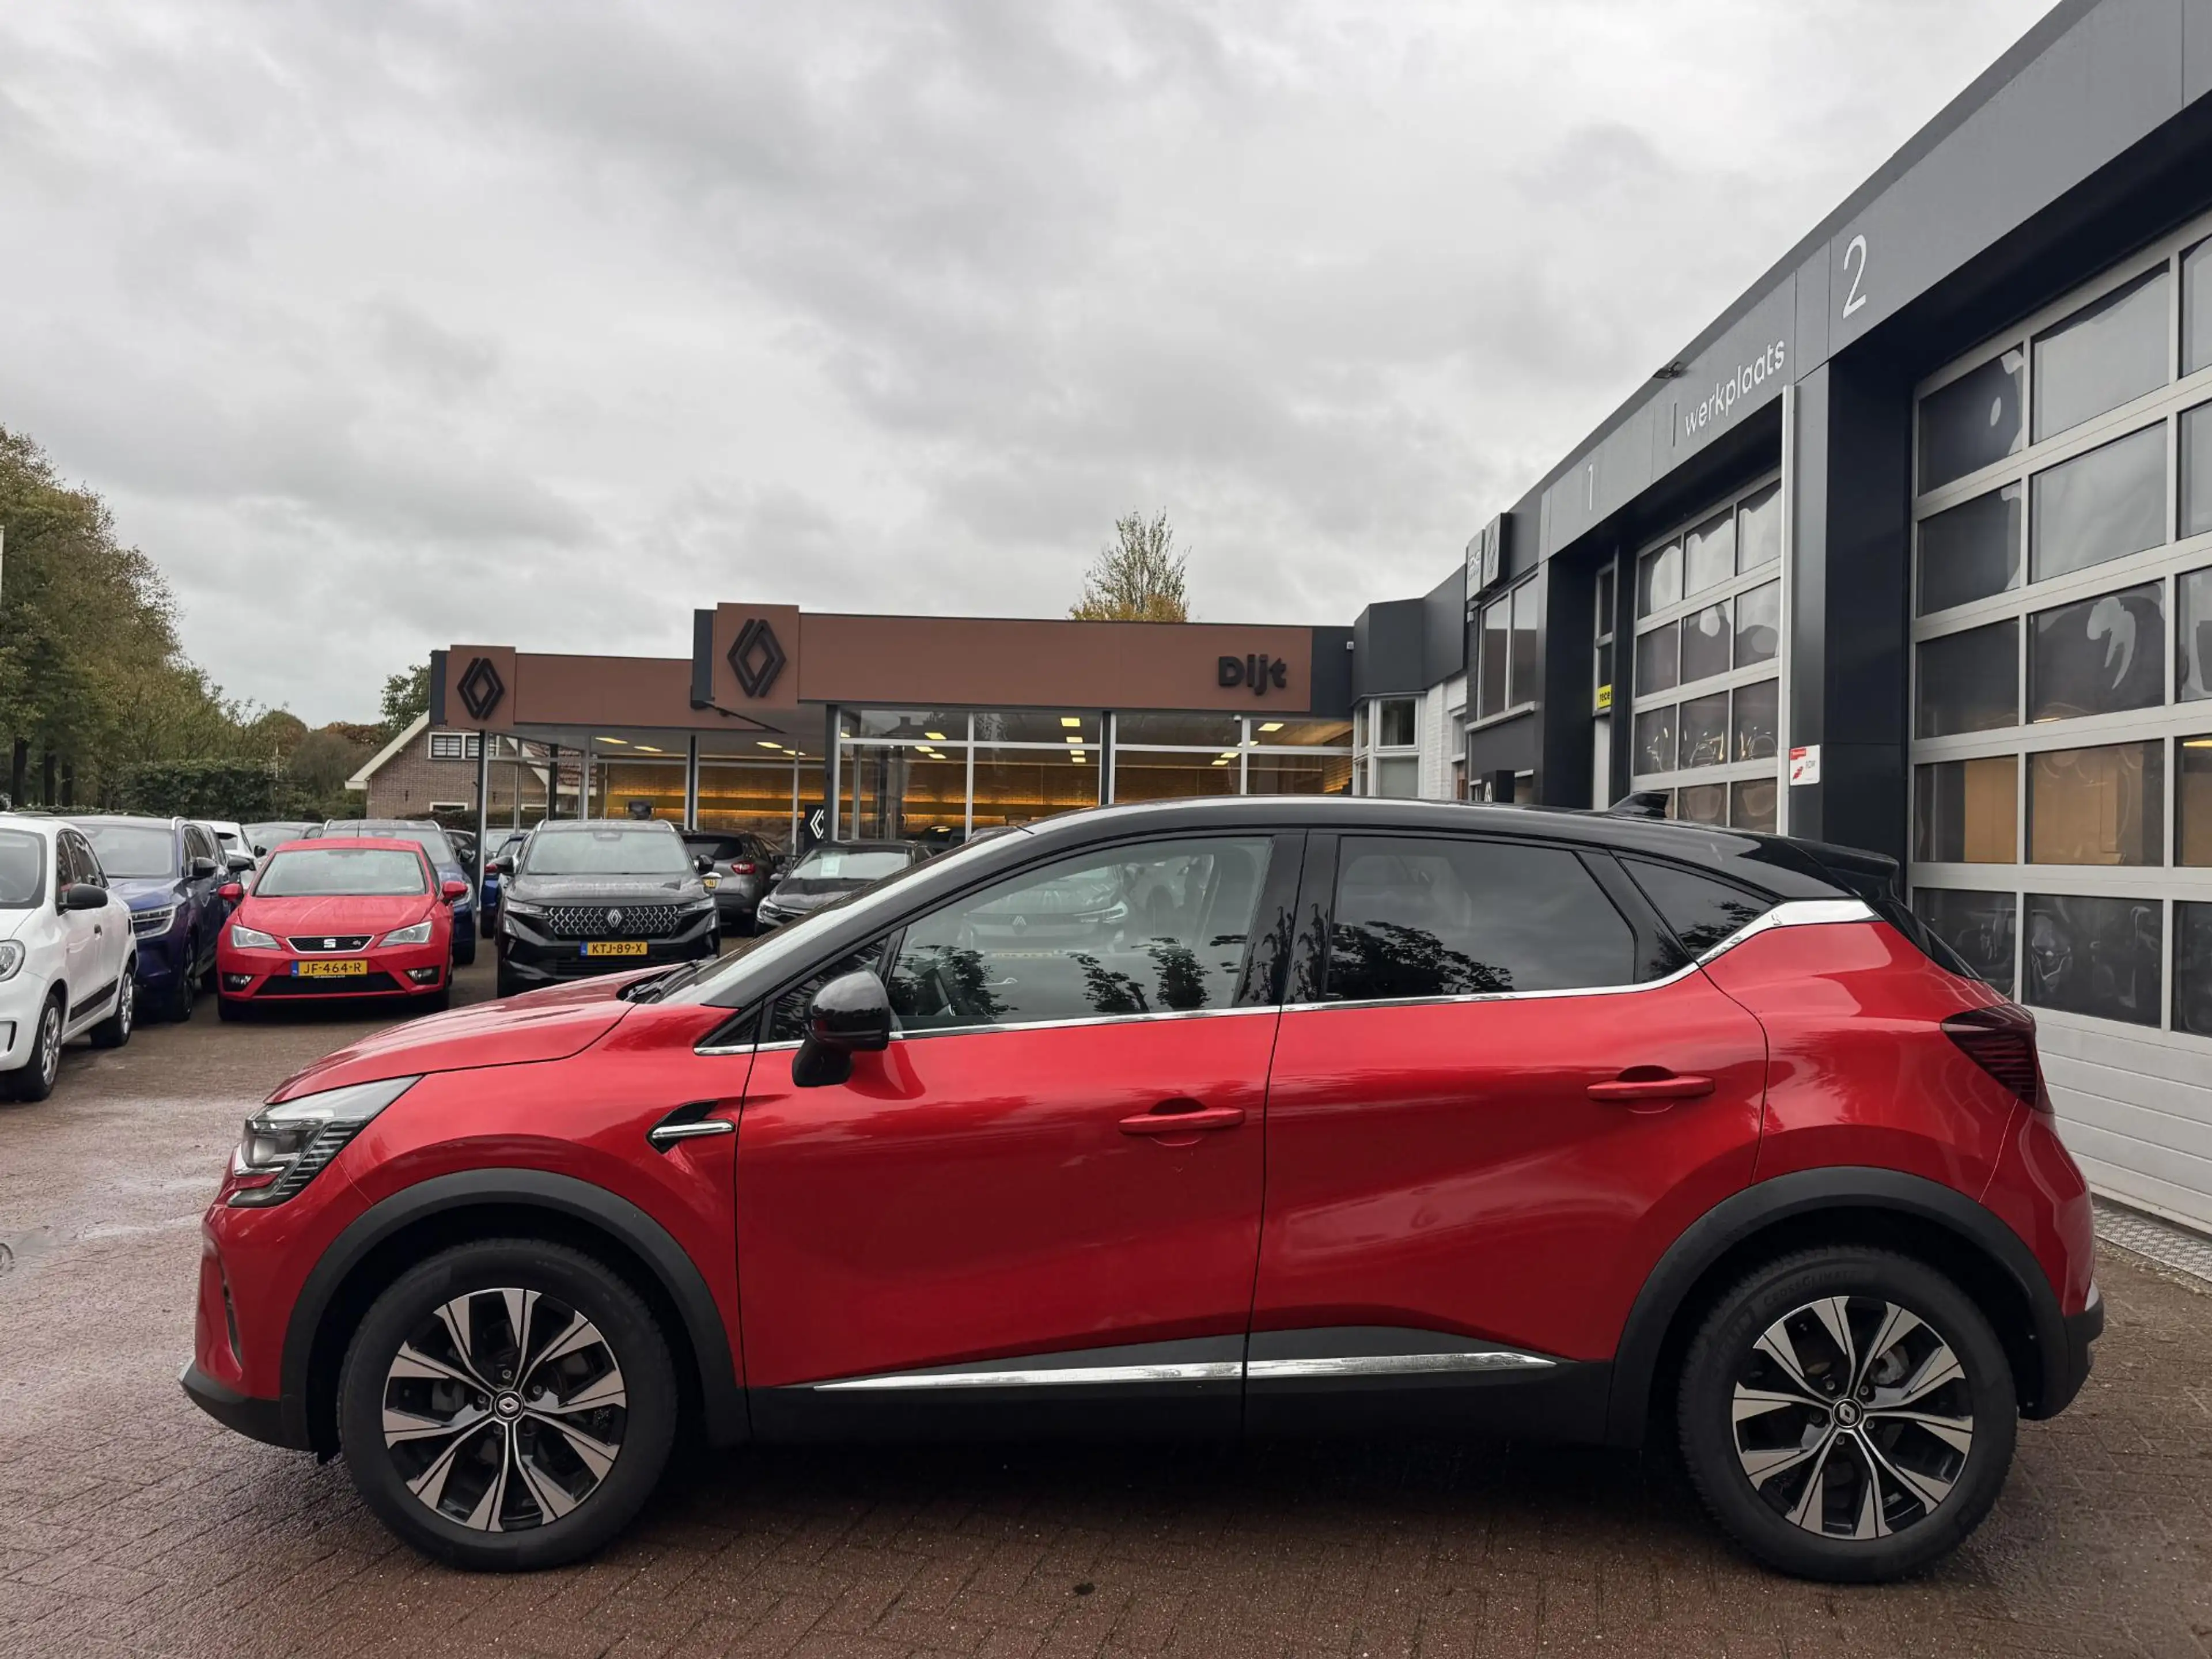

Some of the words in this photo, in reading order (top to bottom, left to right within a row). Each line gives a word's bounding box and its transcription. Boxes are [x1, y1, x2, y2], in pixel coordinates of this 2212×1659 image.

[1843, 234, 1867, 319] 2
[1685, 340, 1785, 438] werkplaats
[1588, 463, 1593, 511] 1
[303, 962, 362, 975] JF-464-R
[592, 943, 642, 954] KTJ-89-X
